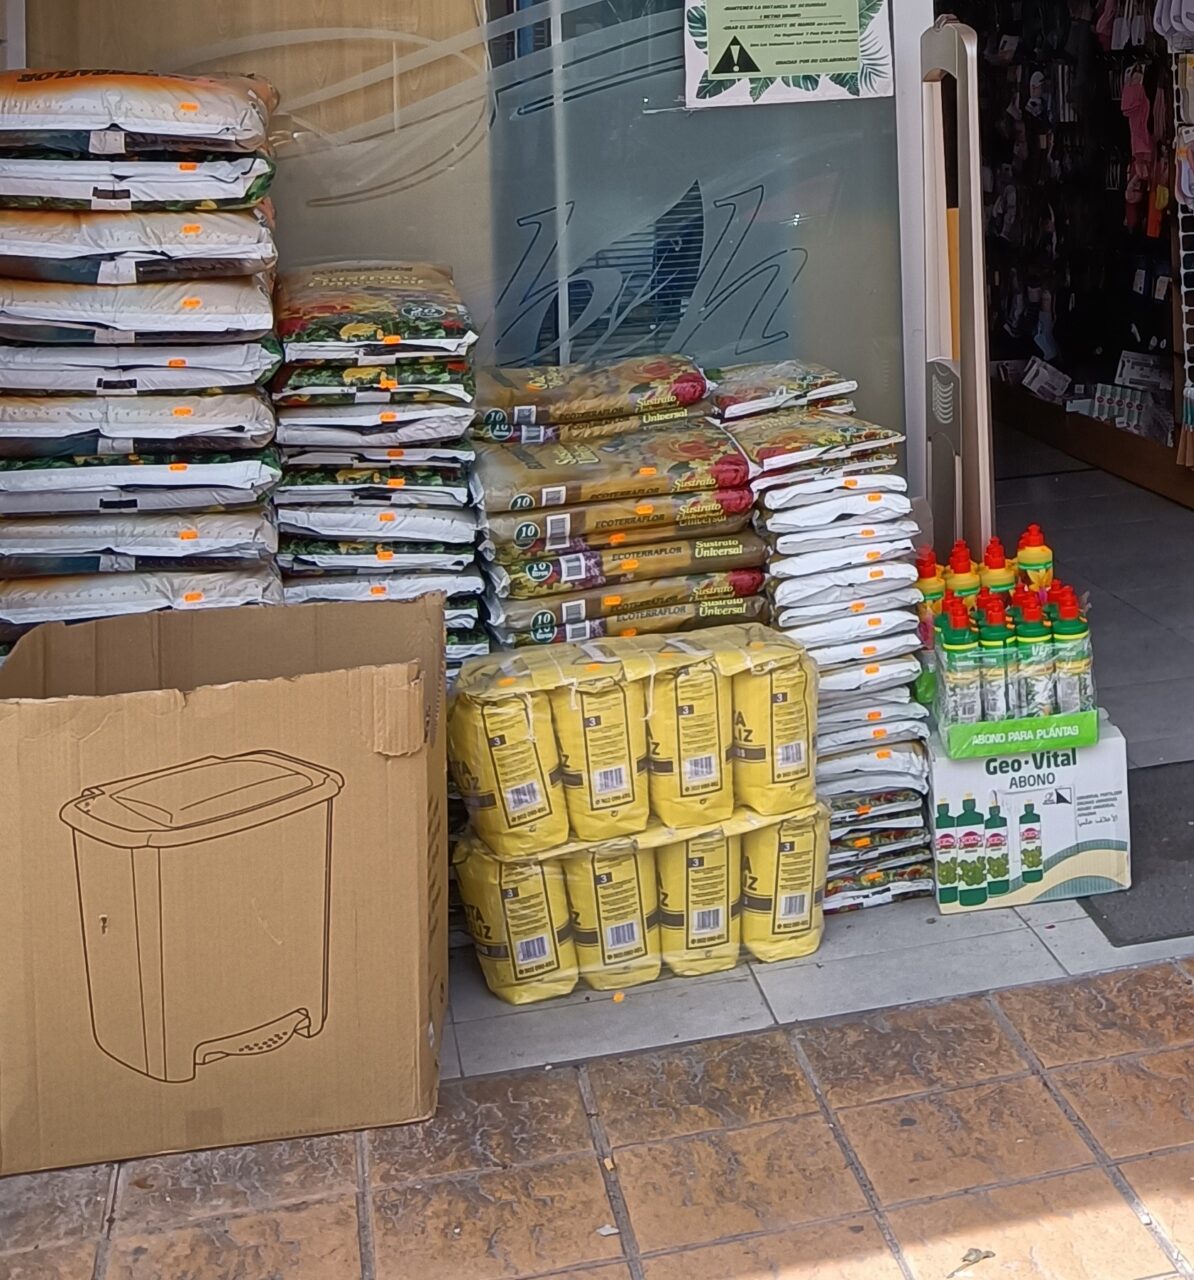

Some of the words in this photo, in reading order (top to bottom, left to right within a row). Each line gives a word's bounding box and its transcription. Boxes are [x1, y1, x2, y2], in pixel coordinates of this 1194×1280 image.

[642, 408, 689, 424] Universal
[516, 497, 531, 508] 10
[594, 513, 666, 529] ECOTERRAFLOR
[521, 525, 536, 537] 10
[695, 539, 739, 549] Sustrato
[611, 546, 682, 562] ECOTERRAFLOR
[694, 545, 743, 558] Universal
[616, 606, 687, 623] ECOTERRAFLOR
[699, 603, 747, 617] Universal
[537, 613, 551, 625] 10
[777, 693, 783, 702] 3
[682, 706, 690, 715] 3
[589, 718, 597, 727] 3
[972, 733, 1005, 746] ABONO
[1007, 729, 1034, 742] PARA
[1036, 724, 1080, 740] PLANTAS
[494, 737, 501, 746] 3
[1008, 772, 1056, 790] ABONO
[784, 842, 791, 851] 3
[692, 858, 700, 867] 3
[601, 874, 608, 884] 3
[507, 888, 514, 898] 3
